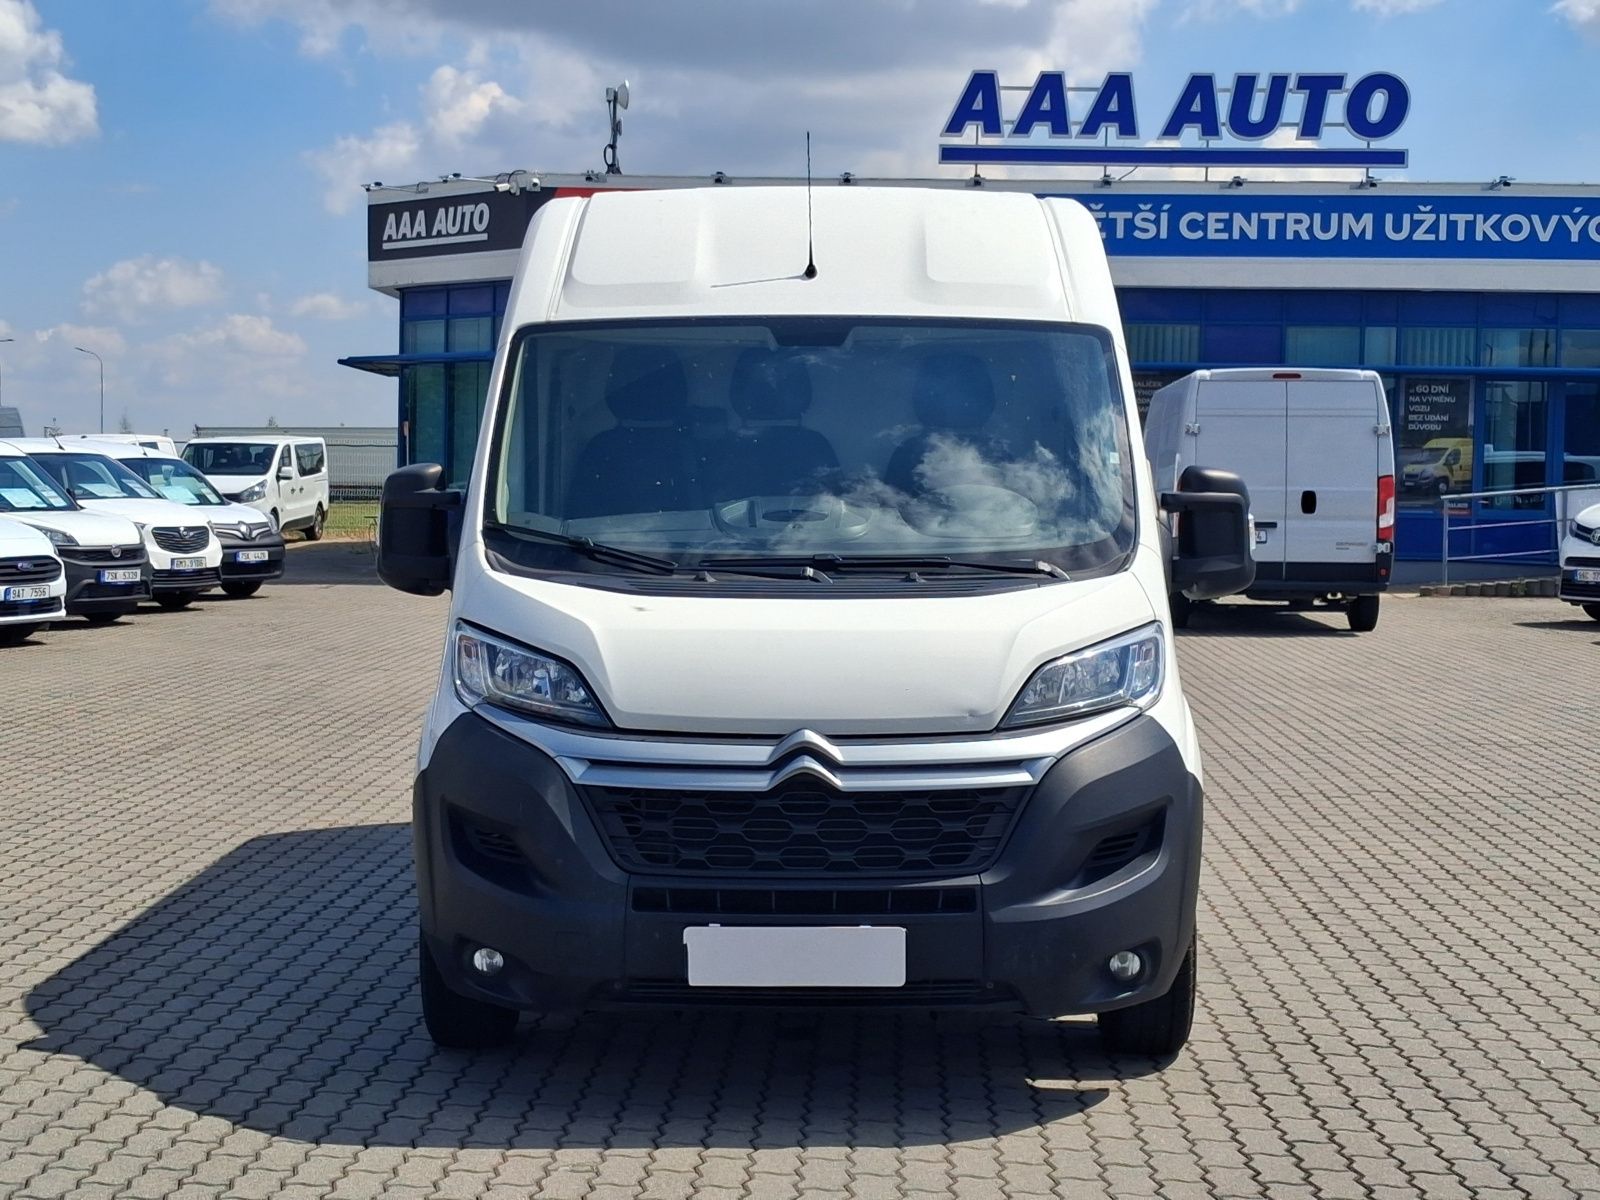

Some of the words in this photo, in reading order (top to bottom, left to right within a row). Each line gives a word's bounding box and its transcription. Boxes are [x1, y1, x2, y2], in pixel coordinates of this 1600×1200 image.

[939, 69, 1140, 139] AAA
[1157, 71, 1411, 141] AUTO
[382, 209, 427, 241] AAA
[432, 203, 490, 236] AUTO
[1179, 211, 1373, 241] CENTRUM
[1415, 384, 1430, 394] 60
[1431, 384, 1449, 394] DNÍ
[1408, 395, 1421, 403] NA
[1408, 404, 1431, 412] VOZU
[1424, 413, 1449, 421] UDÁNÍ
[1408, 422, 1442, 431] DŮVODU
[12, 588, 25, 599] 9AT
[30, 586, 47, 598] 7556
